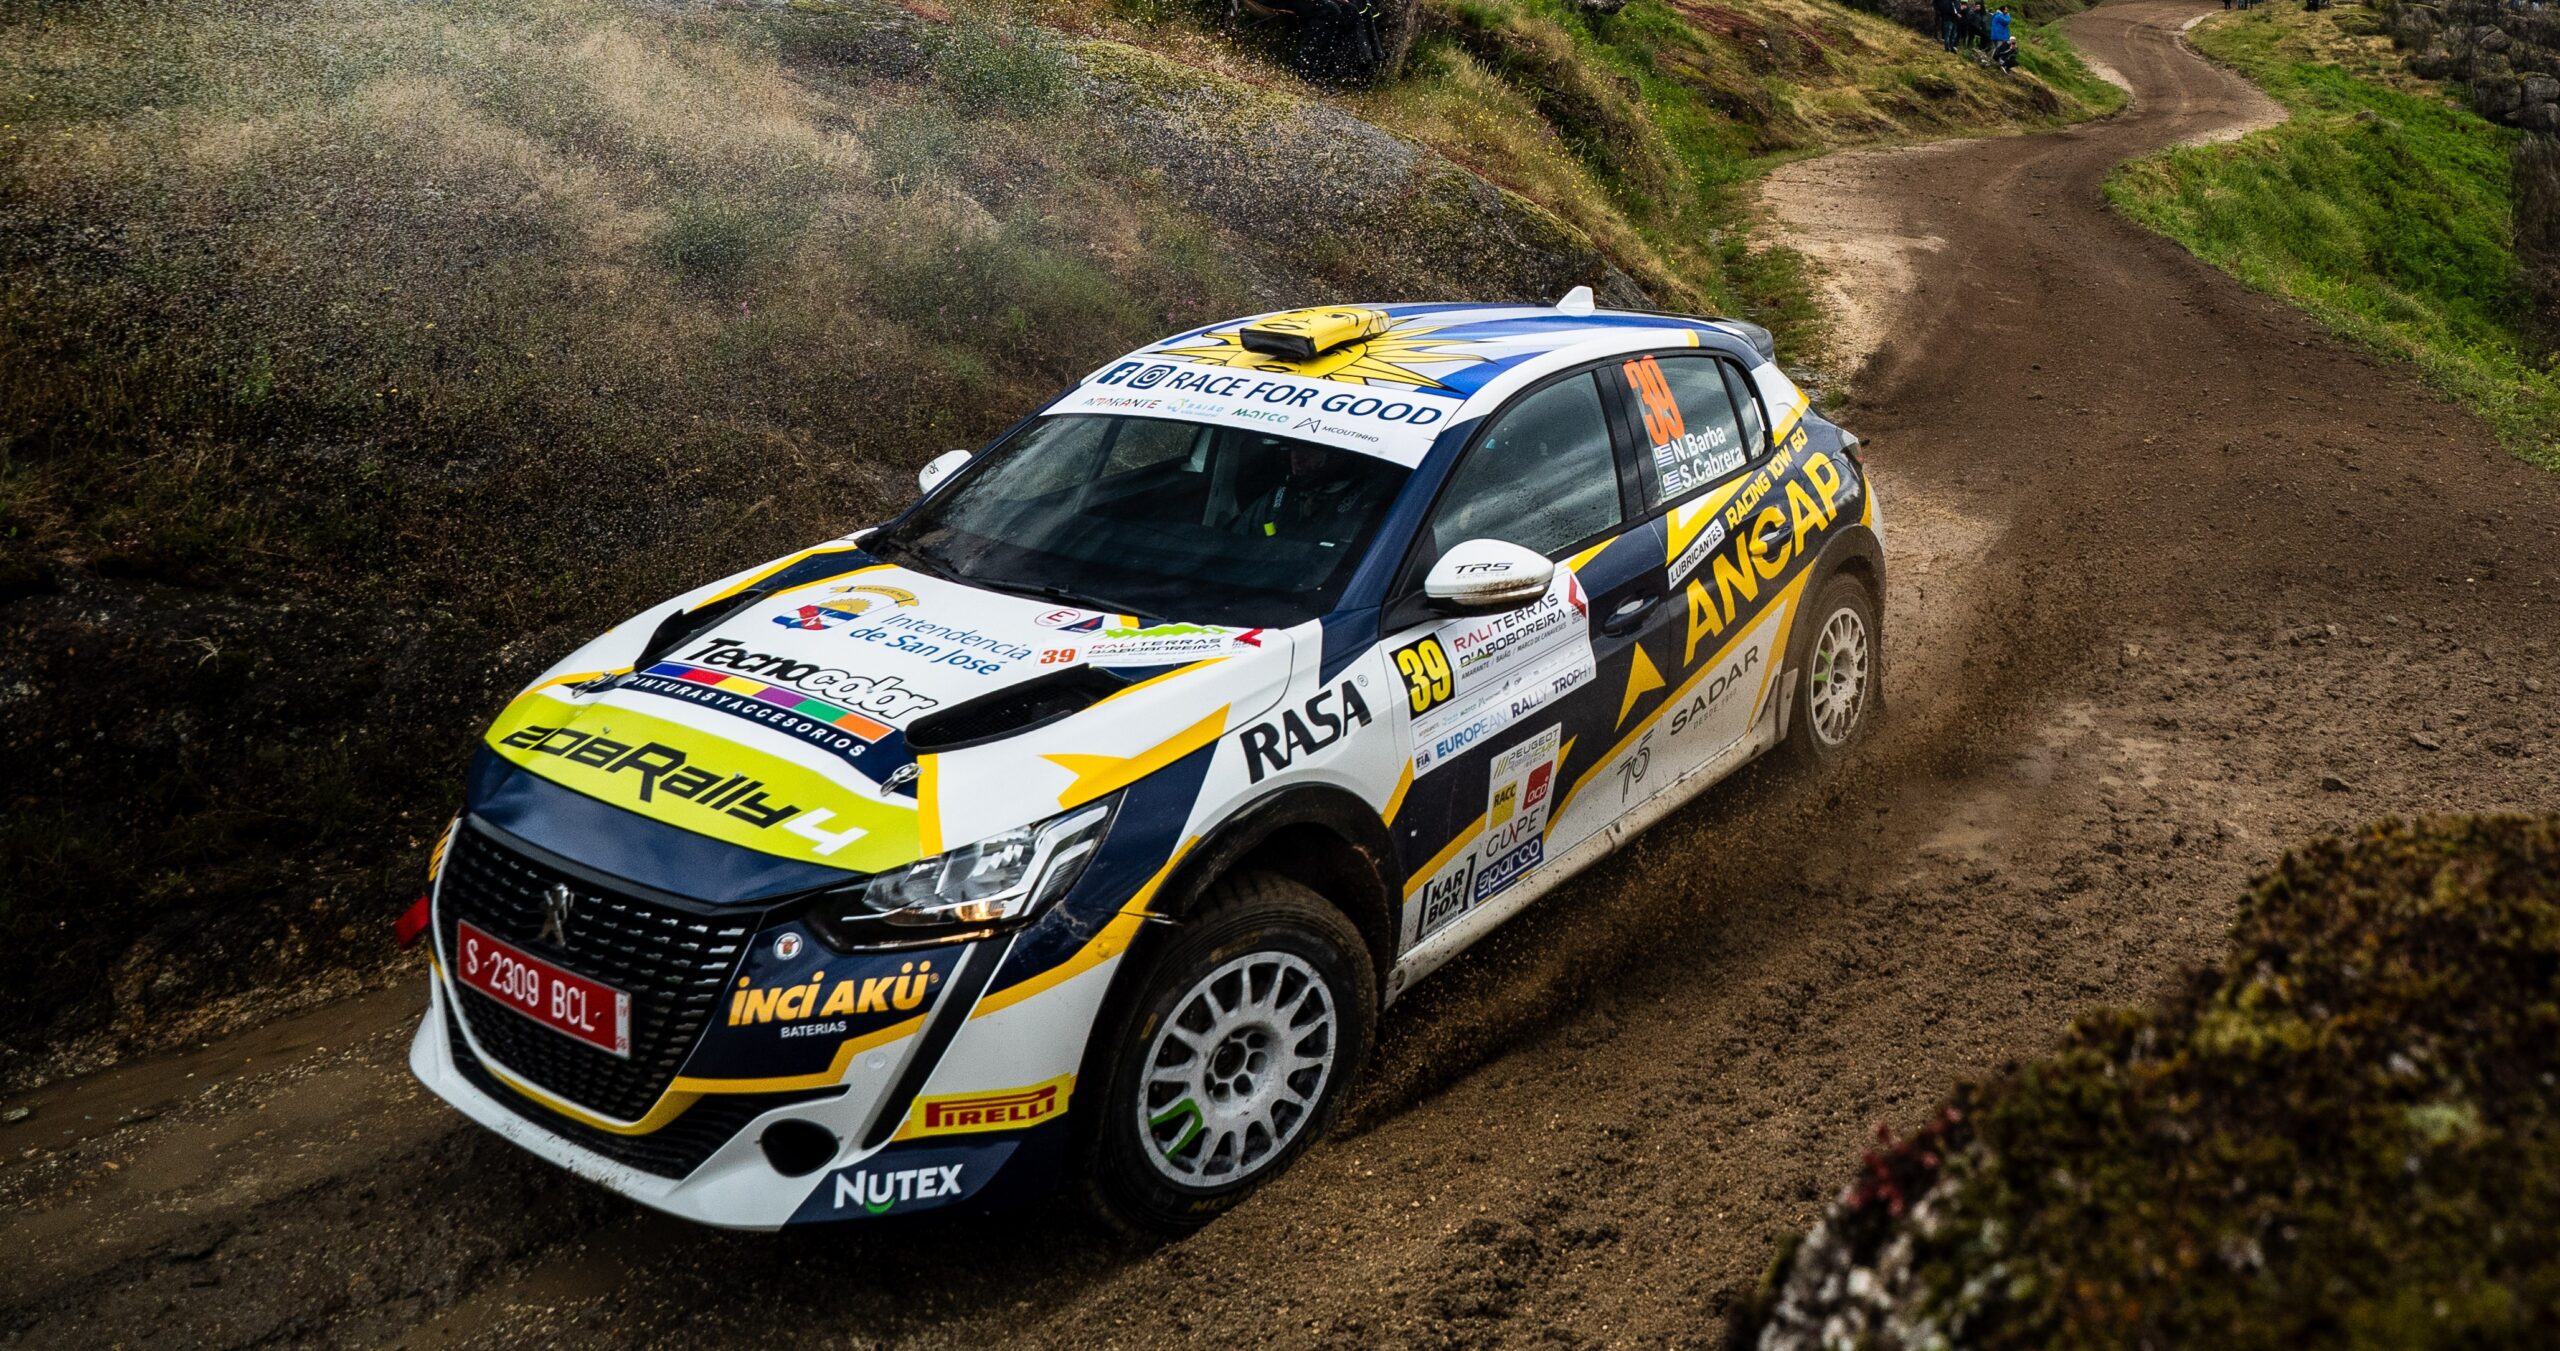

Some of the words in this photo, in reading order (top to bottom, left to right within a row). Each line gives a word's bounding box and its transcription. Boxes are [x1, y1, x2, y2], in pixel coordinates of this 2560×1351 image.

[1164, 371, 1244, 398] RACE
[1244, 382, 1320, 408] FOR
[1321, 393, 1443, 426] GOOD
[1622, 355, 1685, 446] 39
[1321, 426, 1379, 443] MCOUTINHO
[1671, 425, 1727, 463] N.Barba
[1680, 445, 1746, 488] S.Cabrera
[1724, 472, 1771, 530] RACING
[1455, 562, 1514, 575] TRS
[1670, 523, 1724, 585] LUBRICANTES
[1684, 451, 1842, 667] ANCAP
[881, 613, 1032, 660] Intendencia
[1047, 610, 1076, 623] E
[850, 626, 887, 642] de
[885, 634, 940, 657] San
[930, 649, 1008, 676] José
[1039, 648, 1076, 664] 39
[684, 637, 939, 719] Tecnocolor
[1397, 639, 1452, 713] 39
[1670, 645, 1759, 736] SADAR
[1239, 680, 1373, 785] RASA
[1436, 712, 1508, 759] EUROPEAN
[1511, 685, 1548, 718] RALLY
[1552, 662, 1592, 694] TROPHY
[1509, 728, 1559, 762] PEUGEOT
[1494, 784, 1517, 808] RACC
[1431, 868, 1465, 905] KAR
[1478, 839, 1540, 893] sparco
[1426, 887, 1462, 926] BOX
[466, 938, 479, 975] S
[489, 951, 540, 1007] 2309
[551, 979, 596, 1032] BCL
[818, 960, 932, 1018] AKÜ
[780, 1020, 848, 1039] BATERIAS
[925, 1085, 1057, 1129] PIRELLI
[833, 1163, 964, 1210] NUTEX
